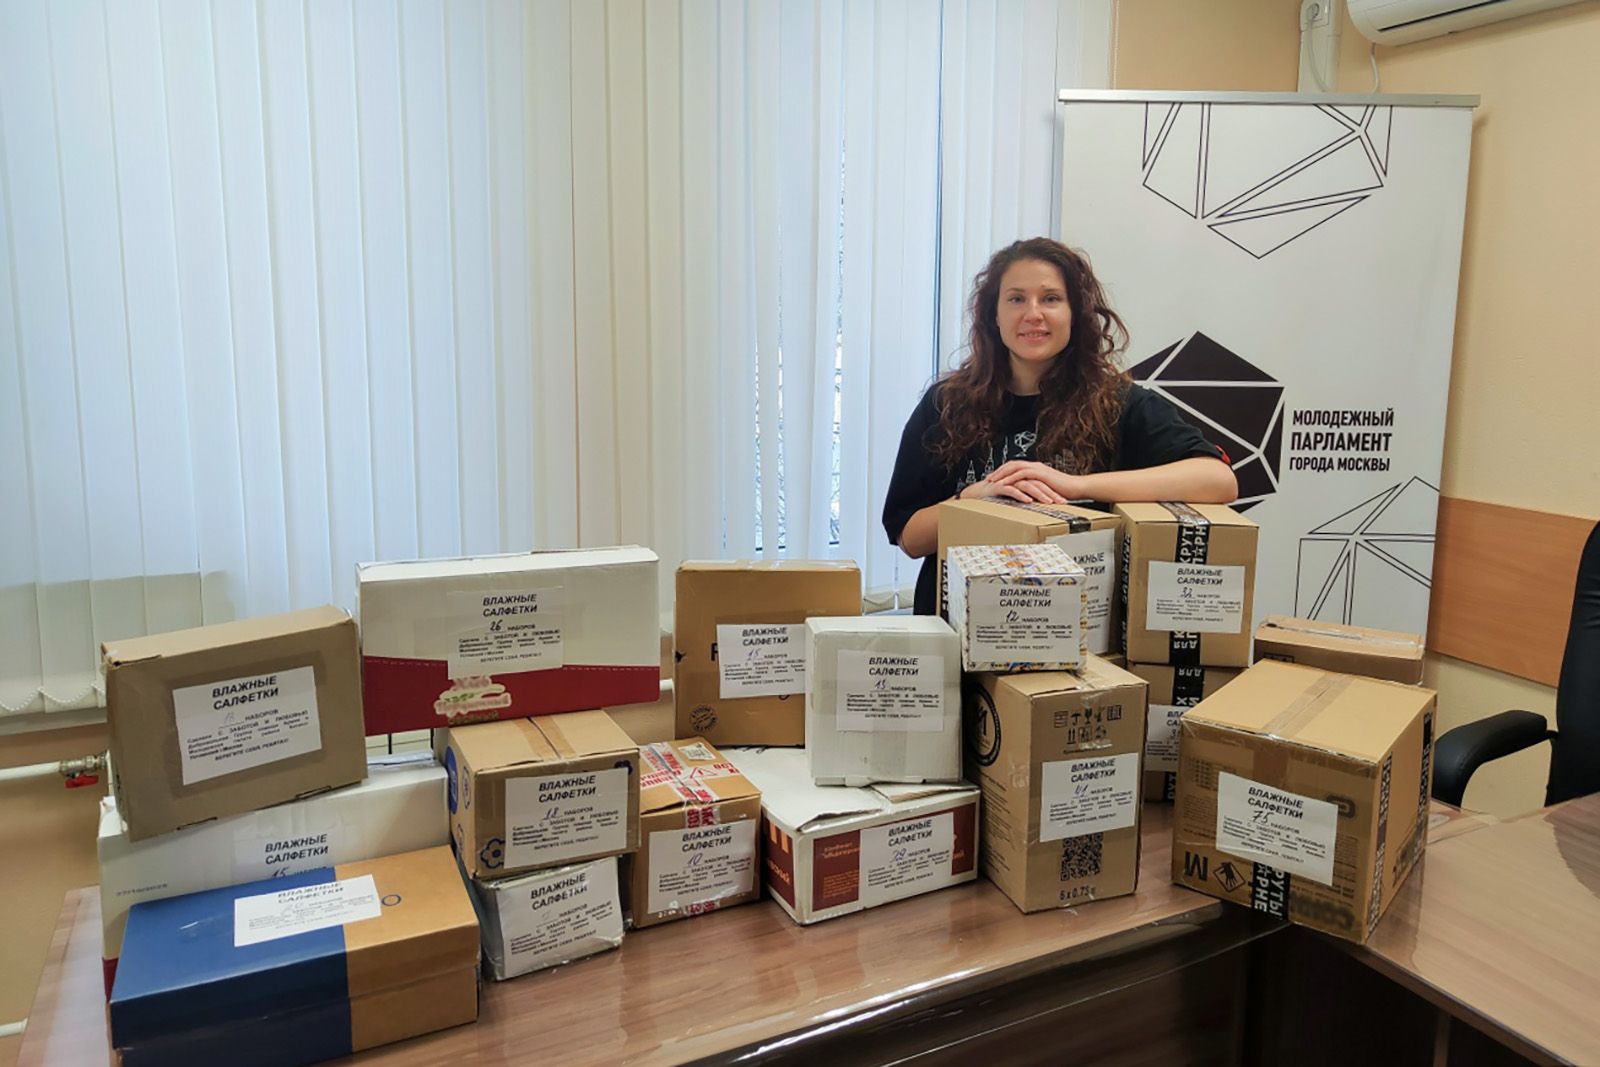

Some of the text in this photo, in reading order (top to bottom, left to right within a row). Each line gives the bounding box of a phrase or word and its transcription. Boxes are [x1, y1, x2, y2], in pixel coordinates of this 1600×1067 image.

[1292, 408, 1394, 428] МОЛОДЕЖНЫЙ
[1291, 432, 1392, 452] ПАРЛАМЕНТ
[1289, 457, 1390, 472] ГОРОДА МОСКВЫ
[1073, 552, 1105, 565] ЖНЫЕ
[1177, 568, 1222, 576] ВЛАЖНЫЕ
[1177, 577, 1222, 585] САЛФЕТКИ
[482, 594, 537, 605] ВЛАЖНЫЕ
[482, 604, 537, 616] САЛФЕТКИ
[741, 627, 787, 635] ВЛАЖНЫЕ
[742, 637, 788, 645] САЛФЕТКИ
[869, 656, 918, 666] ВЛАЖНЫЕ
[869, 666, 918, 676] САЛФЕТКИ
[211, 675, 277, 697] ВЛАЖНЫЕ
[212, 687, 279, 710] САЛФЕТКИ
[1071, 759, 1114, 771] ВЛАЖНЫЕ
[538, 775, 595, 790] ВЛАЖНЫЕ
[539, 787, 595, 802] САЛФЕТКИ
[1248, 786, 1303, 809] ВЛАЖНЫЕ
[1248, 796, 1302, 819] САЛФЕТКИ
[682, 826, 731, 841] ВЛАЖНЫЕ
[888, 819, 932, 836] ВЛАЖНЫЕ
[265, 834, 327, 853] ВЛАЖНЫЕ
[681, 836, 731, 851] САЛФЕТКИ
[888, 830, 932, 846] САЛФЕТКИ
[265, 847, 329, 865] САЛФЕТКИ
[530, 872, 586, 898] ВЛАЖНЫЕ
[531, 884, 587, 910] САЛФЕТКИ
